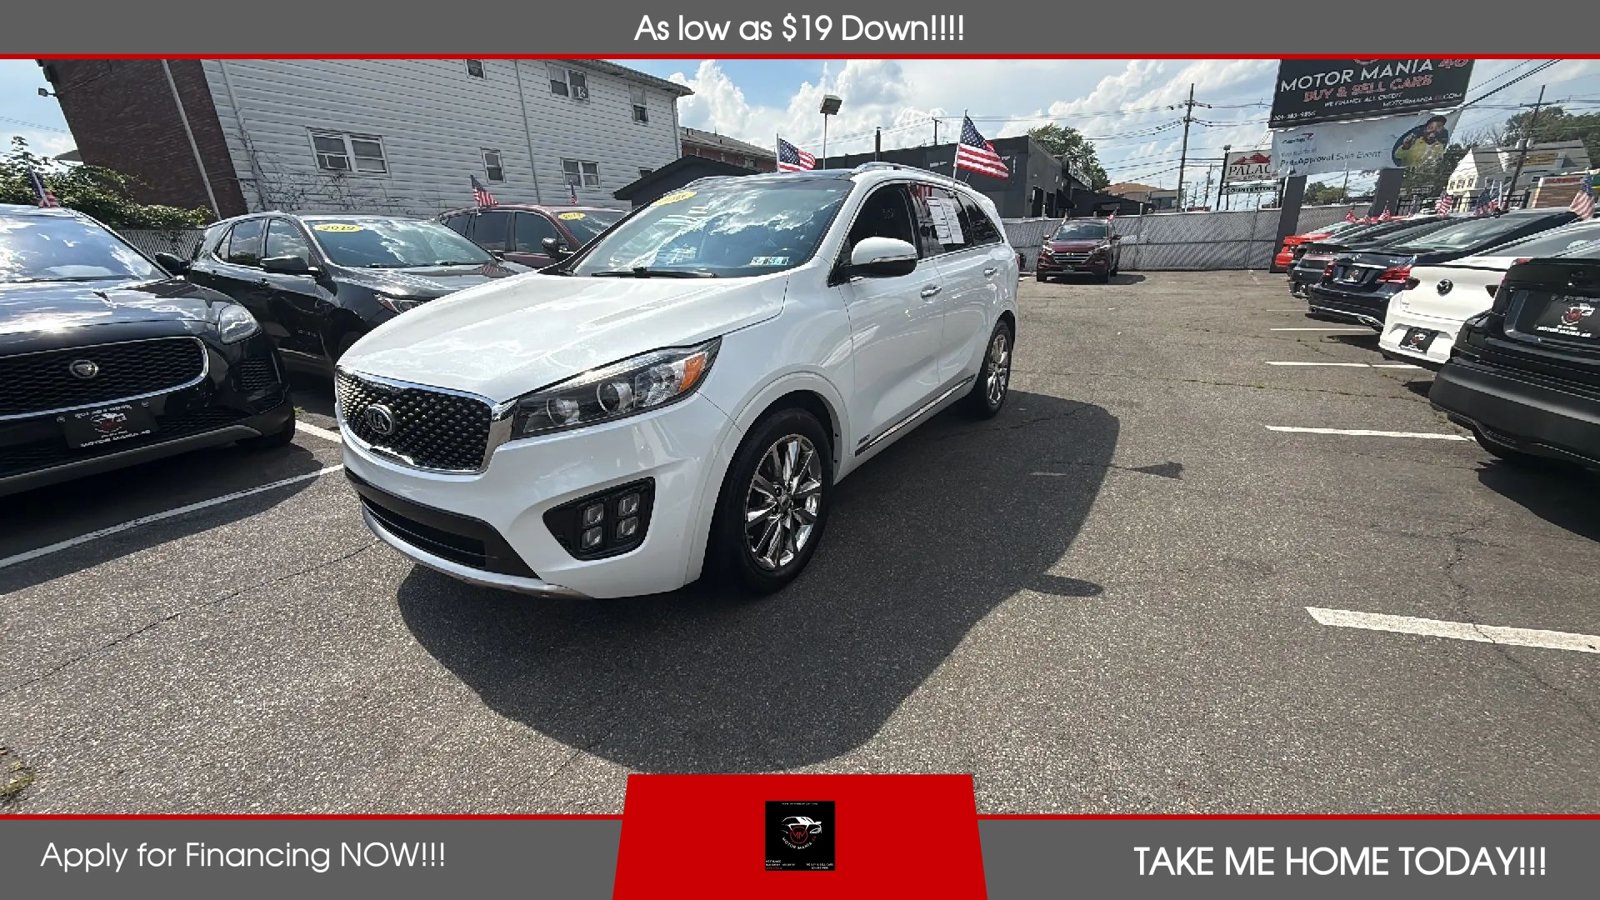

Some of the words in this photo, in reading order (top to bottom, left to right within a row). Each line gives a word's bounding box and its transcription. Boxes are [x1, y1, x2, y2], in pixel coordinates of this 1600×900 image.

[1281, 69, 1354, 92] MOTOR
[1361, 58, 1433, 81] MANIA
[1304, 88, 1335, 102] BUY
[1228, 164, 1272, 176] PALAC
